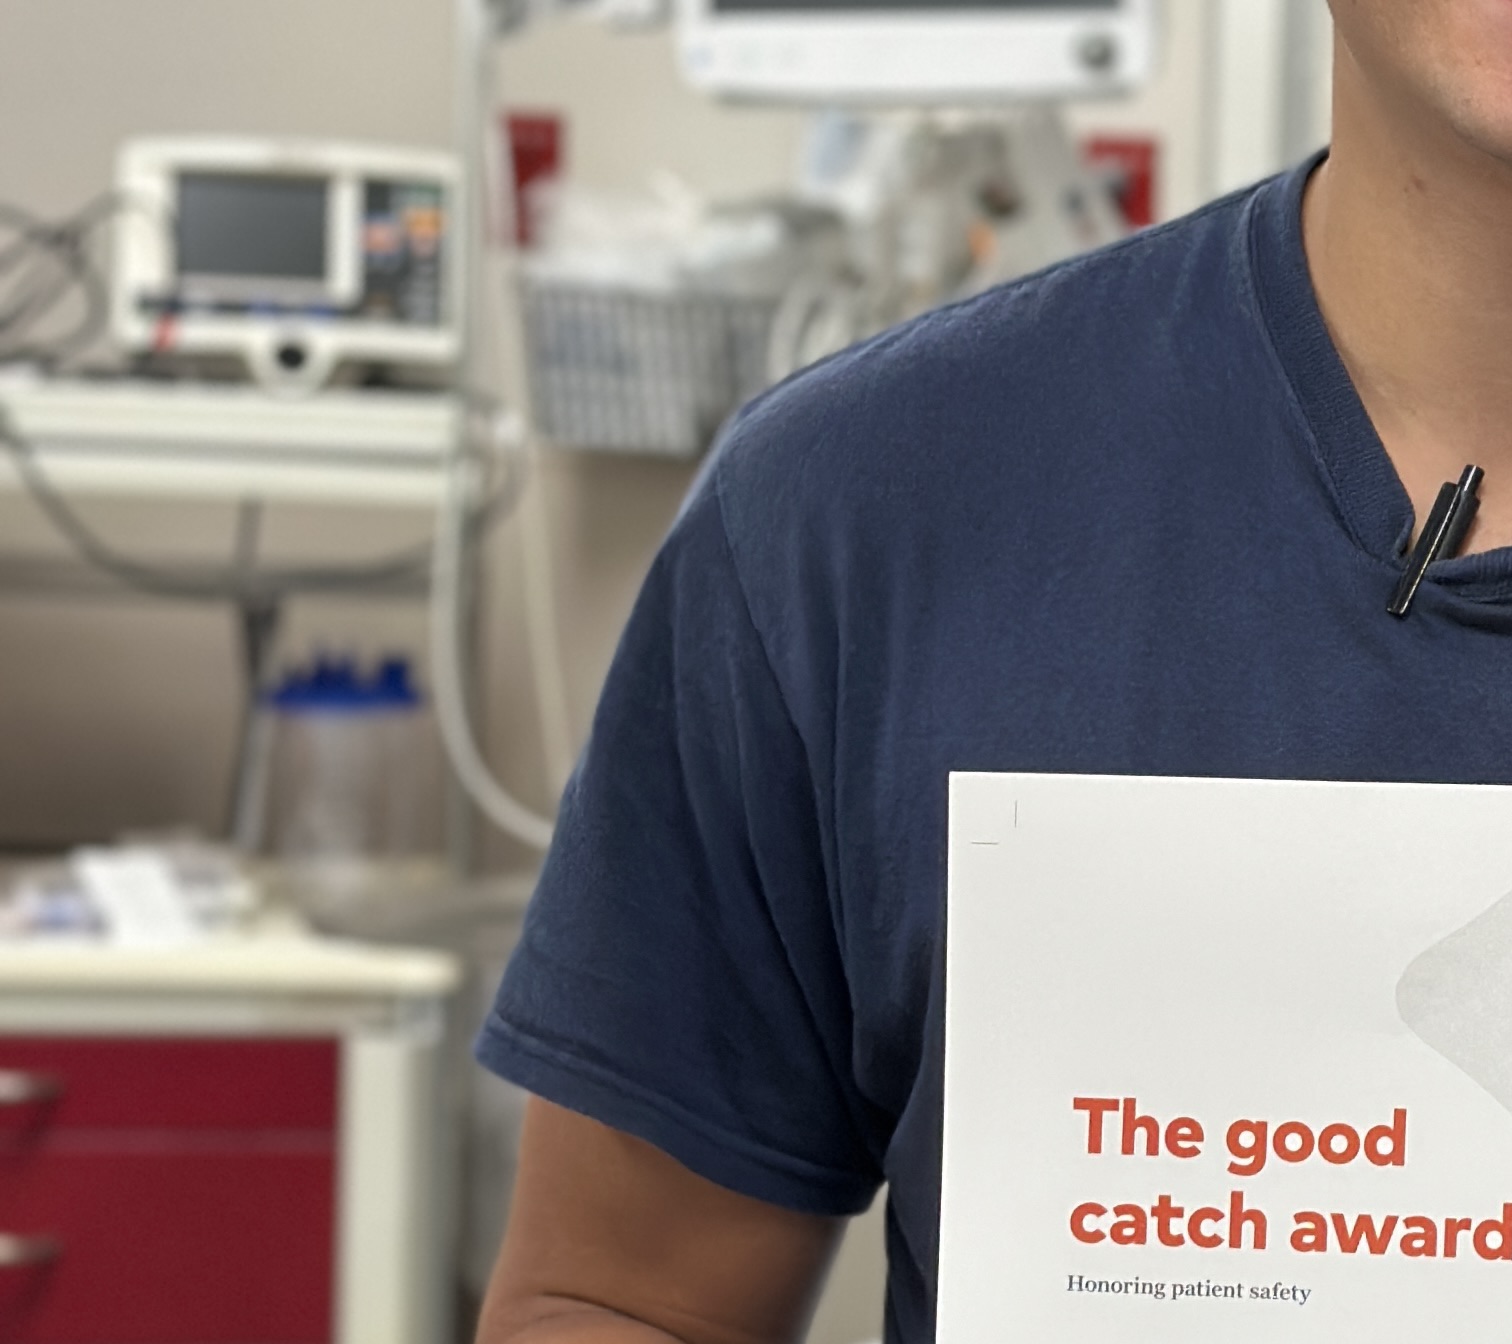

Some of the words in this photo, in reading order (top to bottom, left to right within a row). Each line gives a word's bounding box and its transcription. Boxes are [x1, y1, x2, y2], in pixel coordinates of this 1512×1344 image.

[1072, 1096, 1205, 1159] The
[1225, 1107, 1408, 1177] good
[1069, 1189, 1267, 1251] catch
[1066, 1274, 1167, 1300] Honoring
[1170, 1279, 1244, 1301] patient
[1248, 1281, 1313, 1306] safety
